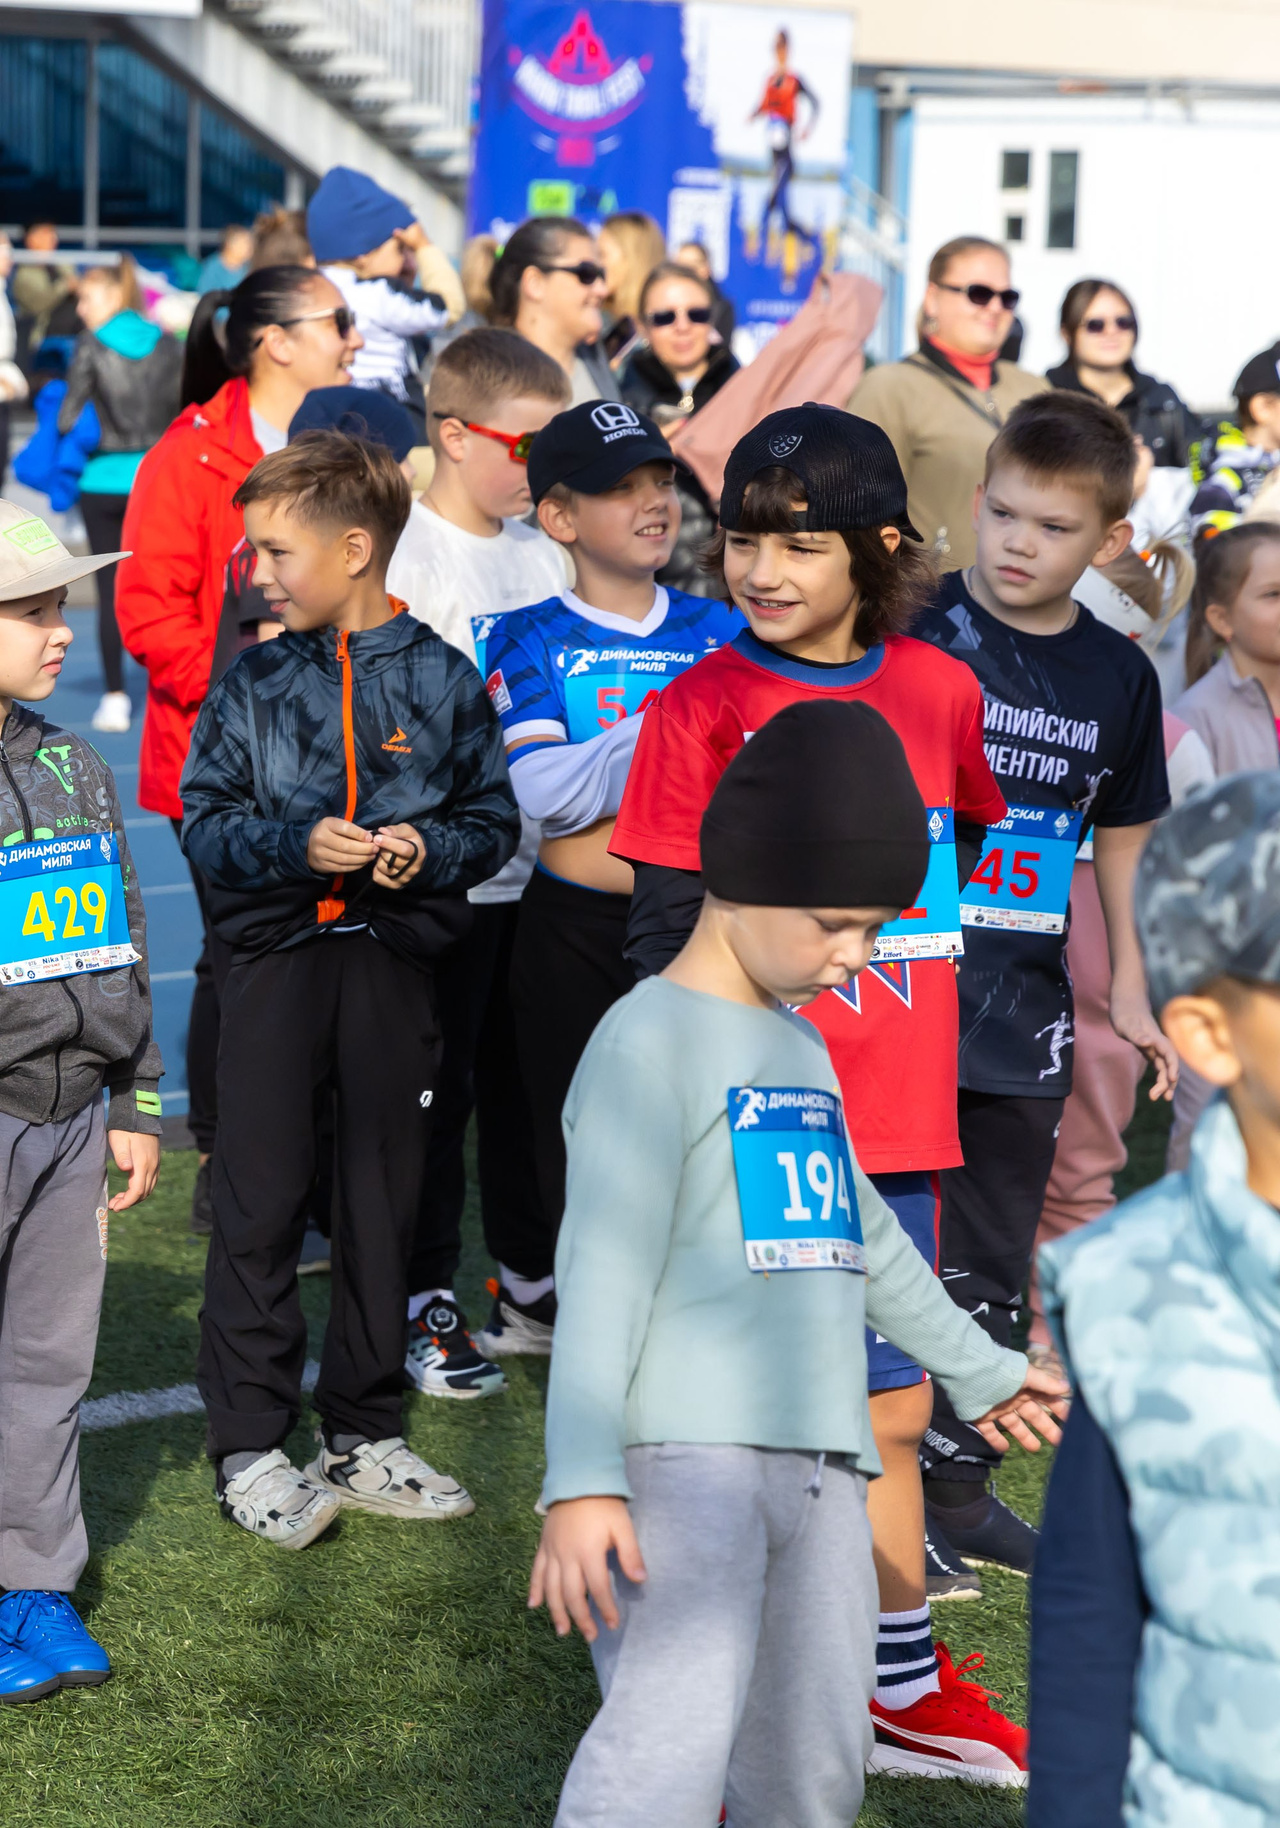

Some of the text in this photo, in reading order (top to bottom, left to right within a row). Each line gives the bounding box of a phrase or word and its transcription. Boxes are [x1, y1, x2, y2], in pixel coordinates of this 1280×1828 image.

[603, 428, 648, 443] HONDA
[599, 650, 695, 663] ДИНАМОВСКАЯ
[630, 661, 666, 672] МИЛЯ
[381, 743, 412, 754] DEMIX
[8, 838, 92, 864] ДИНАМОВСКАЯ
[41, 855, 73, 870] МИЛЯ
[969, 848, 1041, 899] 45
[22, 882, 107, 942] 429
[42, 955, 60, 965] Nika
[777, 1151, 851, 1222] 194
